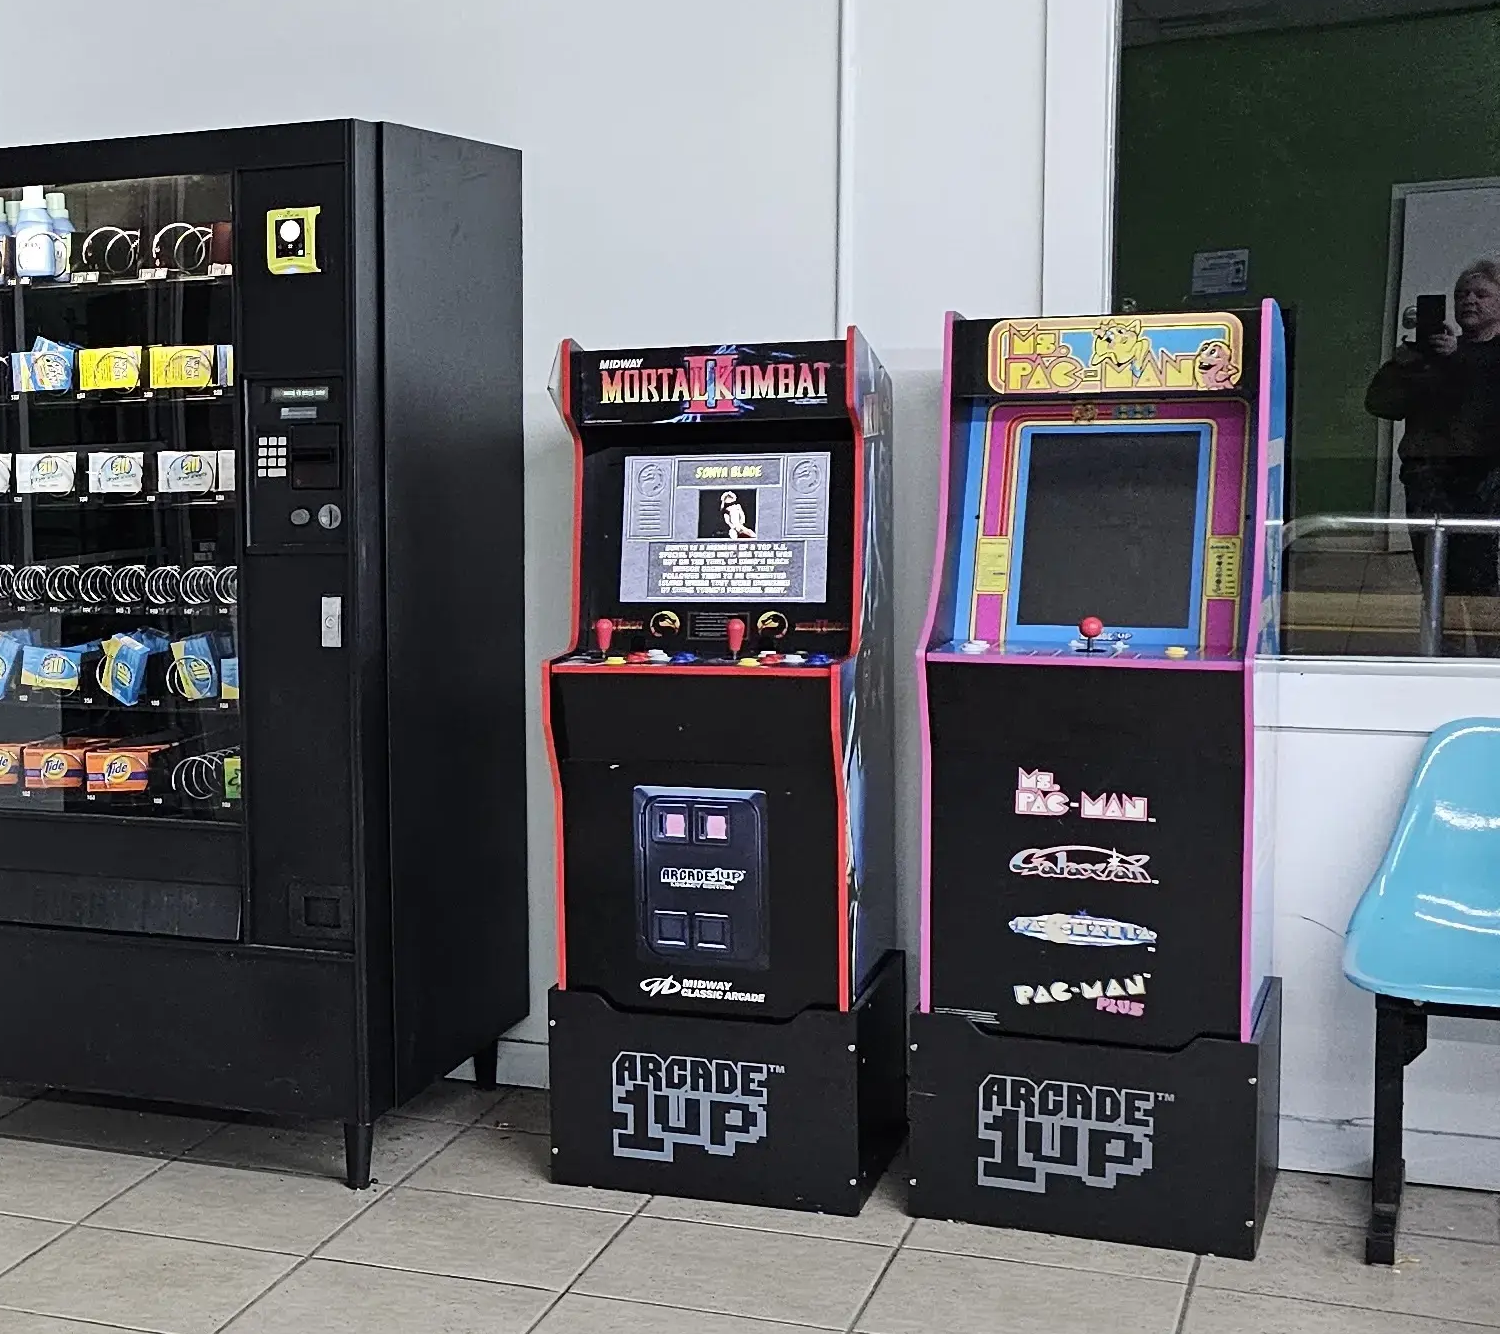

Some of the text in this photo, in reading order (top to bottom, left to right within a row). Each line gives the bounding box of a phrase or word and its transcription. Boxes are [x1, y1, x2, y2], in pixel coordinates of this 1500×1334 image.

[598, 357, 644, 370] MIDWAY
[1004, 350, 1196, 391] PAC-MAN
[599, 368, 710, 404] MORTAL
[713, 362, 831, 400] KOMBAT
[39, 458, 56, 475] all
[112, 457, 129, 474] all
[182, 457, 200, 474] all
[695, 464, 762, 479] SONYA BLADE
[43, 659, 65, 675] all
[44, 760, 65, 773] Tide
[107, 763, 128, 776] Tide
[1015, 790, 1148, 822] PAC-MAN
[1009, 845, 1152, 884] Galaxian
[681, 978, 733, 991] MIDWAY
[1013, 974, 1147, 1006] PAC-MAN
[680, 988, 765, 1003] CLASSIC ARCADE
[1096, 996, 1145, 1017] PLUS
[612, 1051, 768, 1099] ARCADE
[978, 1073, 1155, 1128] ARCADE
[612, 1083, 768, 1162] 1UP
[978, 1108, 1153, 1193] 1UP
